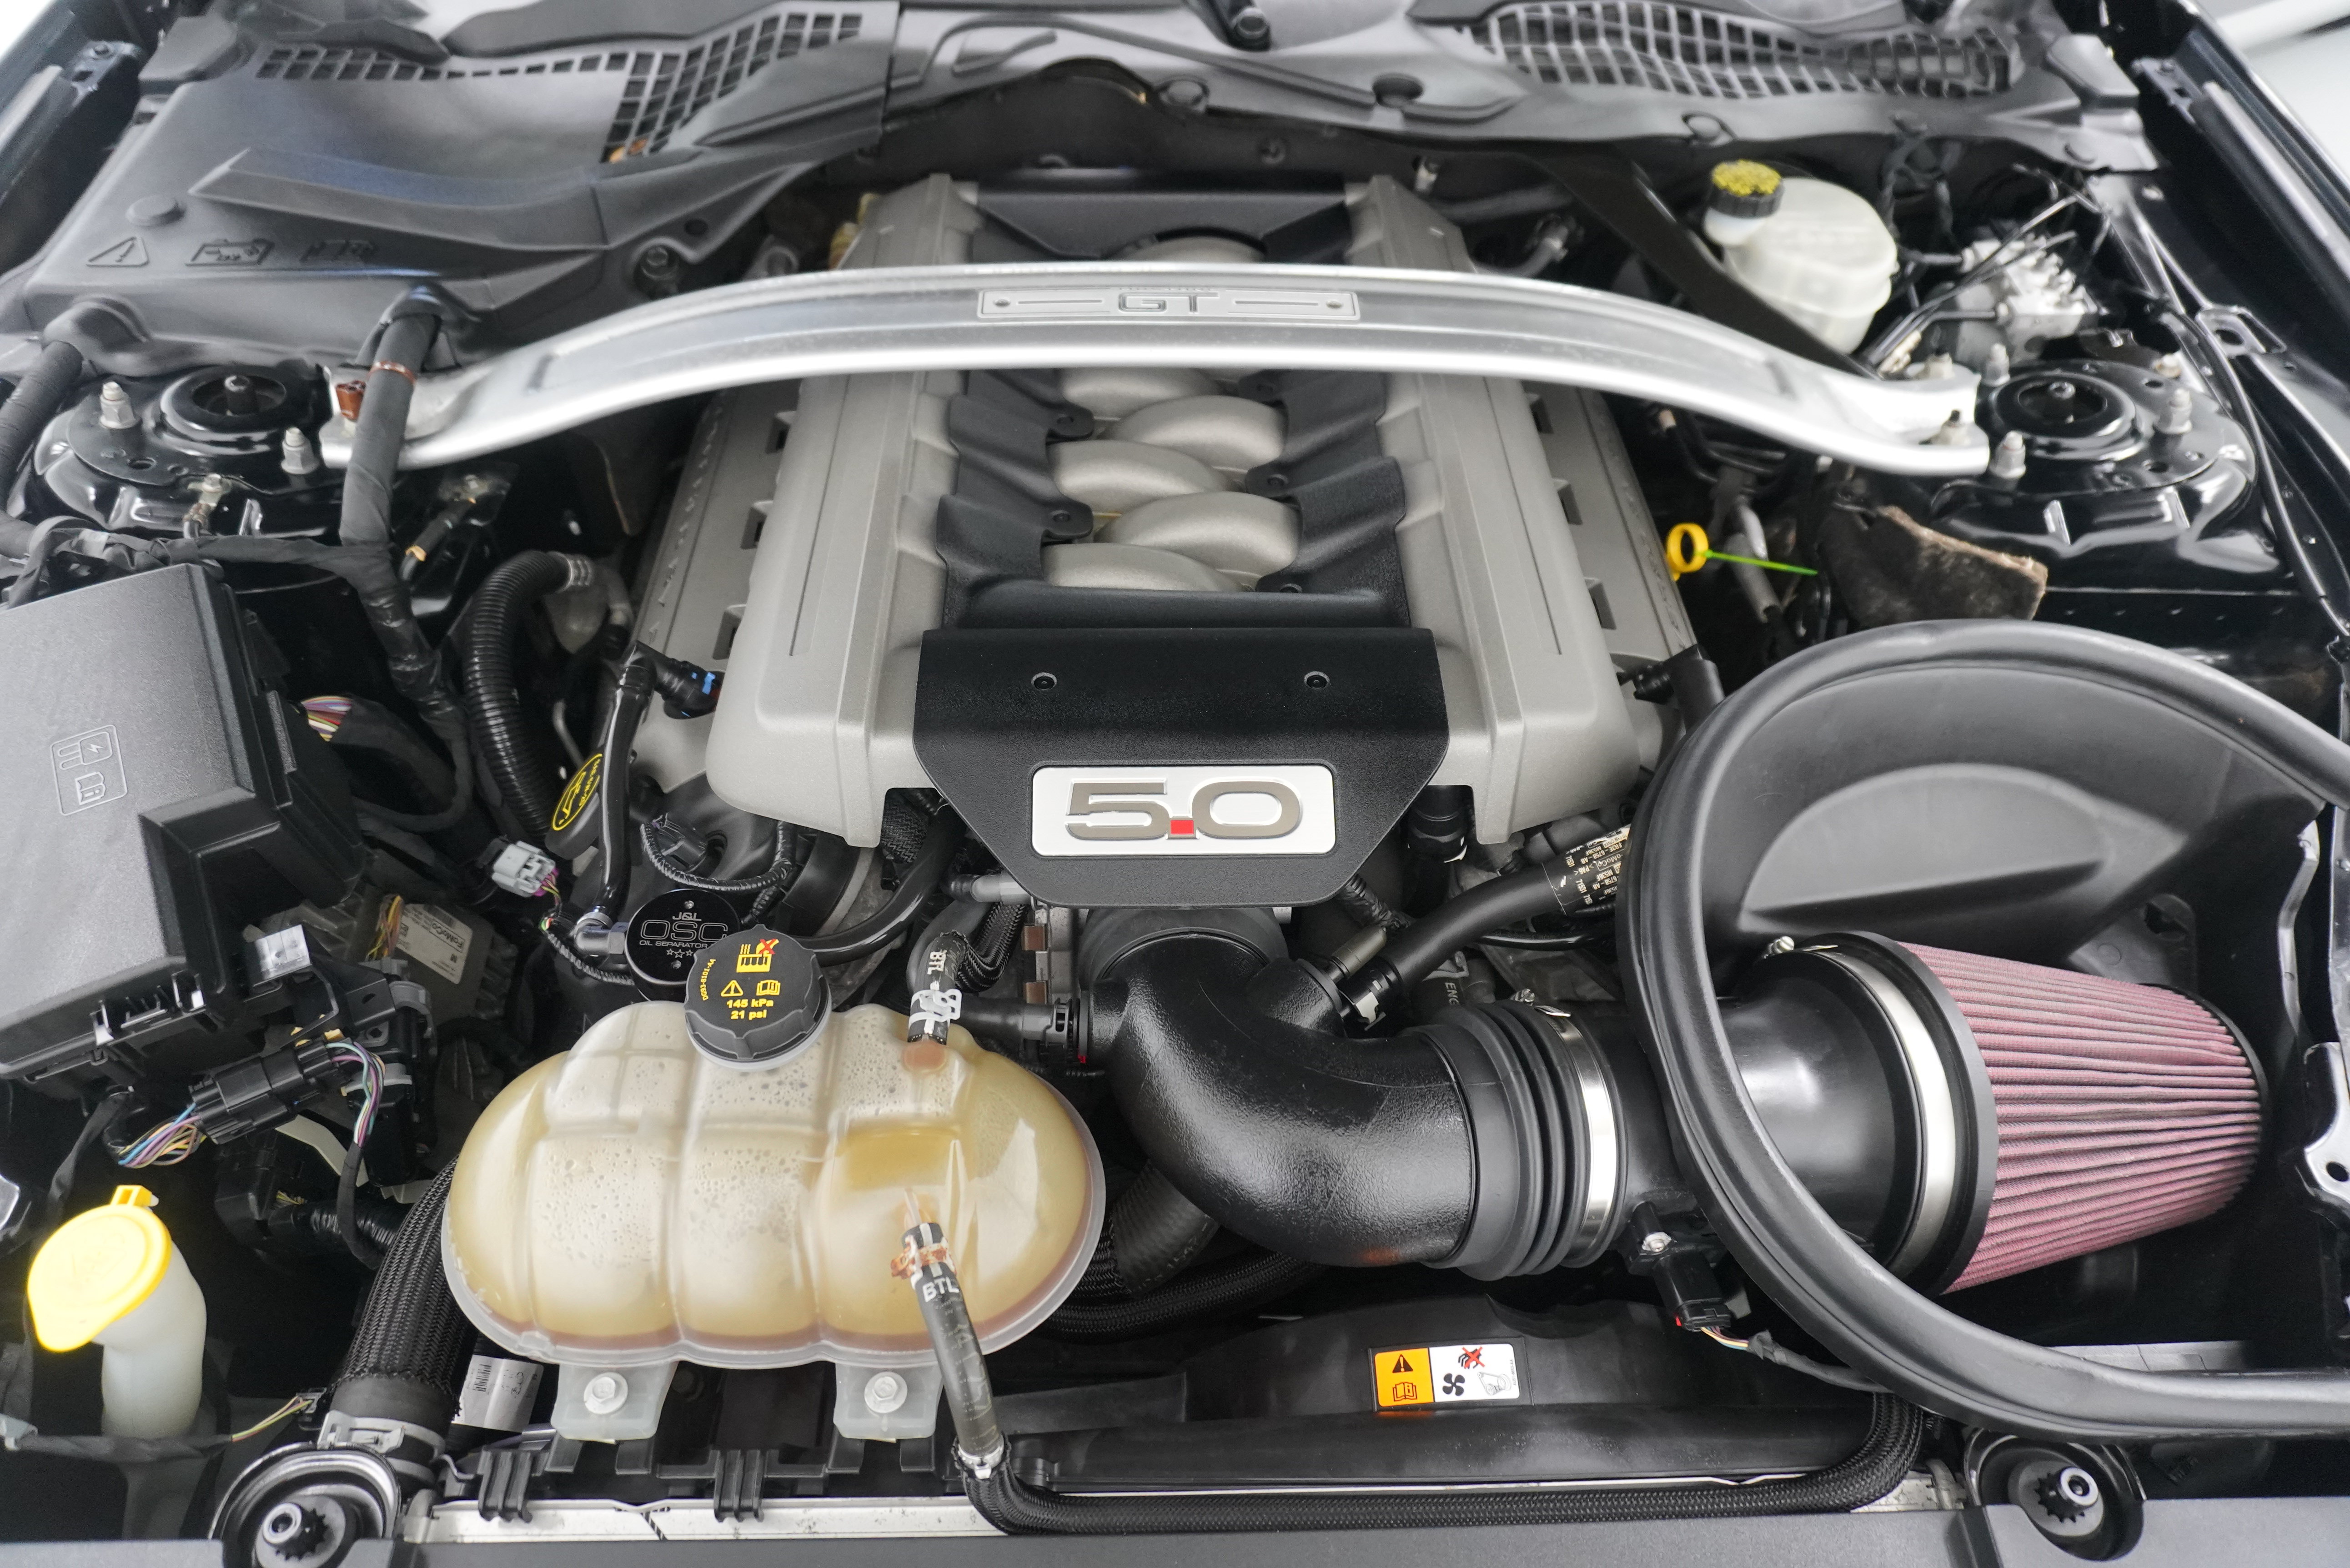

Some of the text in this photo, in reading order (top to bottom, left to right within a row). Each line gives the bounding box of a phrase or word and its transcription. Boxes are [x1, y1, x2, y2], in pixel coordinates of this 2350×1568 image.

[1118, 291, 1220, 313] GT
[1065, 777, 1303, 840] 5.0
[1597, 854, 1623, 867] oMoCo
[672, 912, 702, 921] J&L
[432, 923, 463, 948] FoMoCo
[640, 920, 728, 942] OSC
[727, 998, 774, 1009] 145 kPa
[730, 1010, 767, 1020] 21 psi
[922, 1276, 959, 1302] BTL
